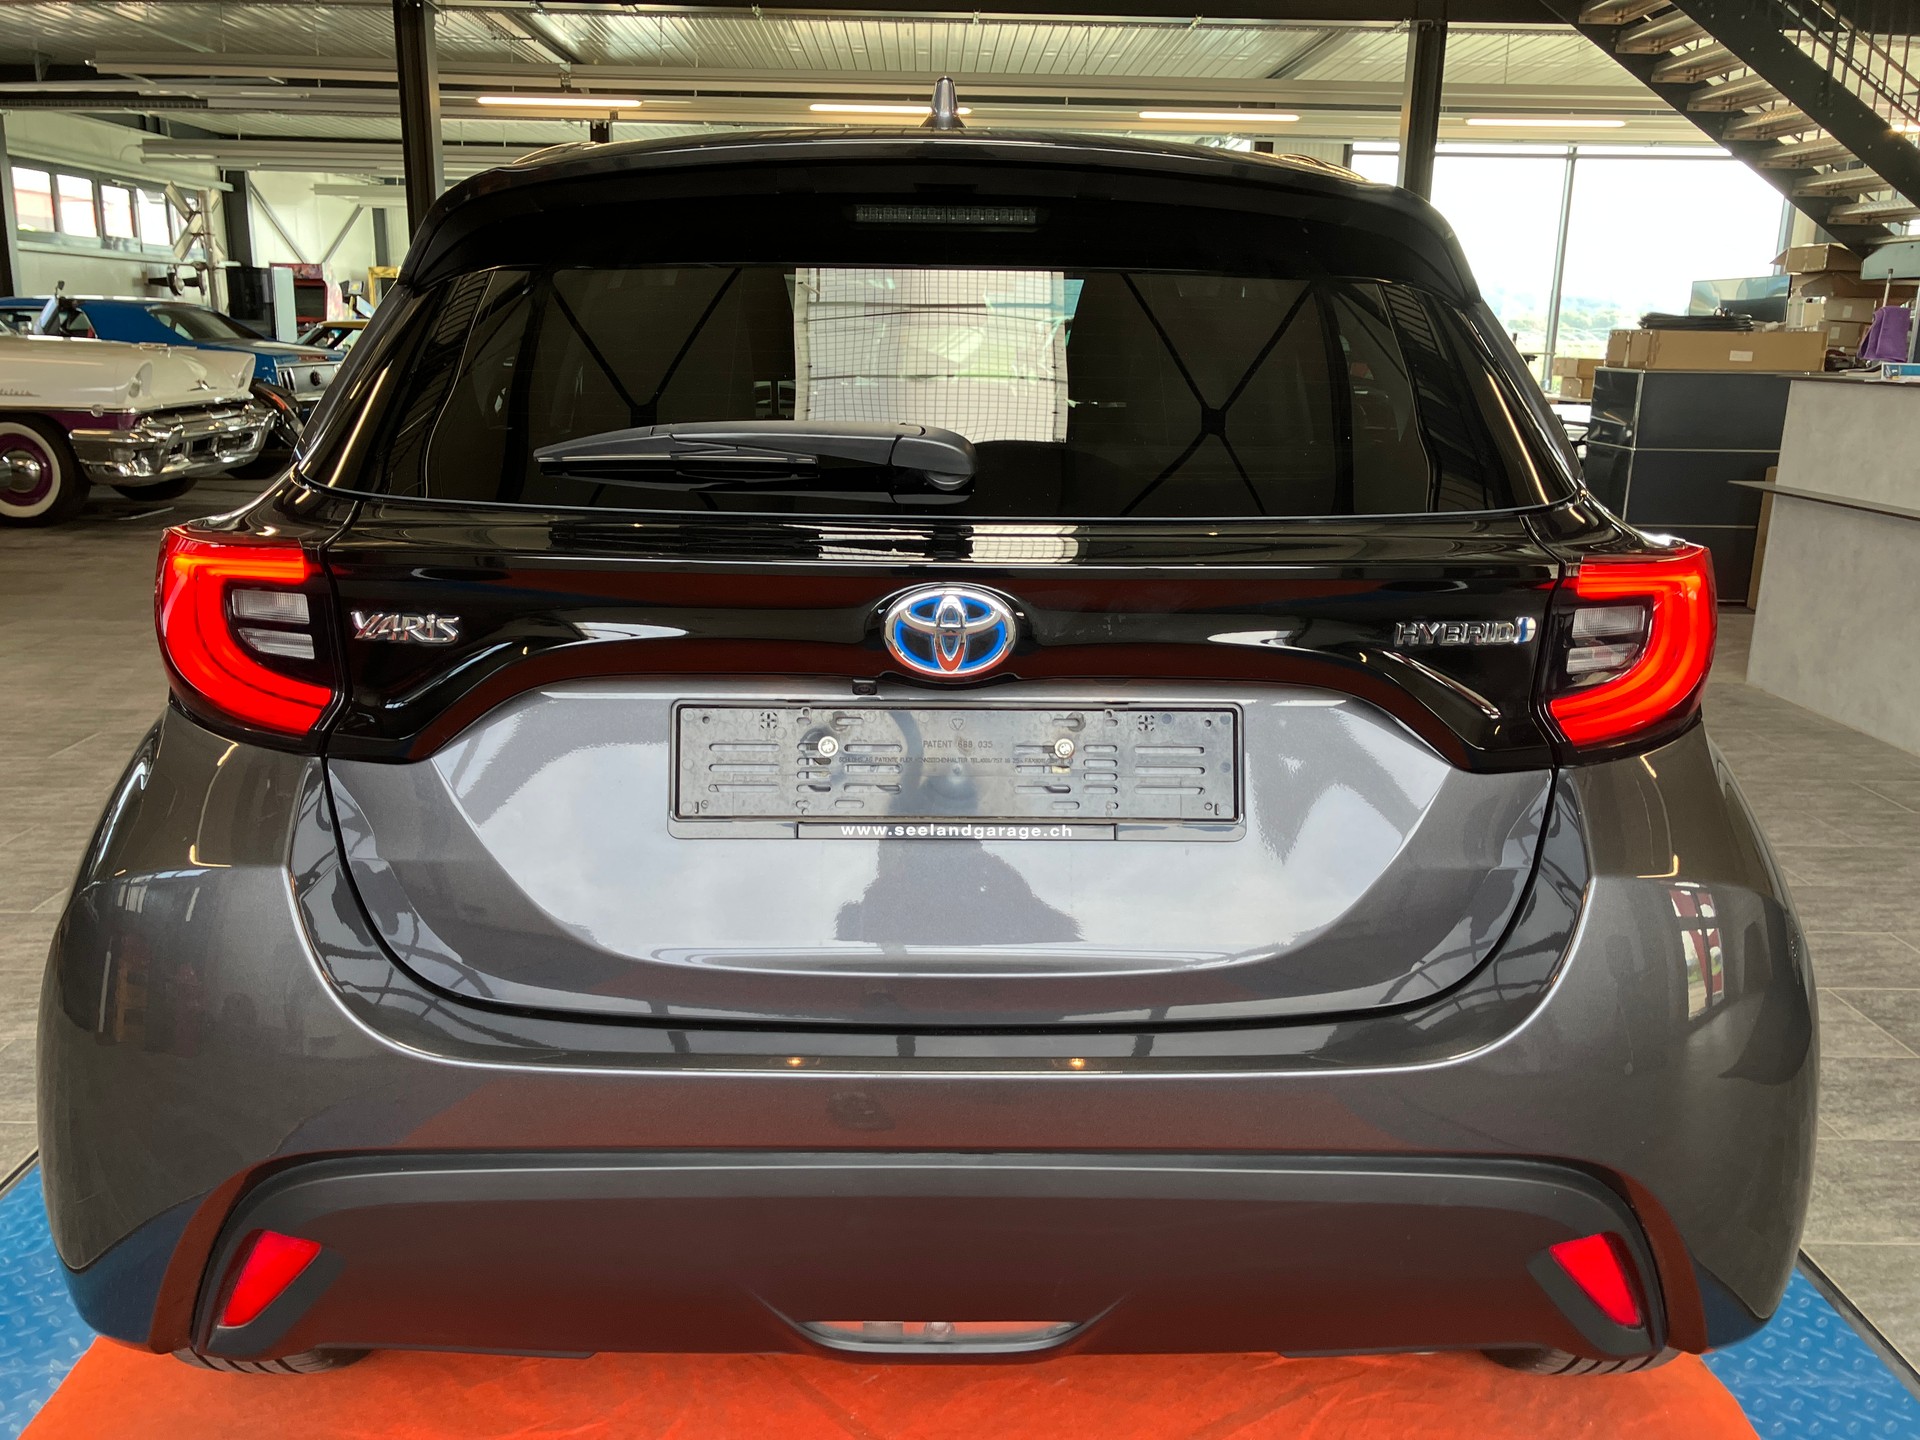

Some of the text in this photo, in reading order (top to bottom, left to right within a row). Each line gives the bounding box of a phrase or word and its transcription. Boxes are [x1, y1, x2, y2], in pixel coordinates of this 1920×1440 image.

[350, 611, 460, 644] YARIS
[1394, 621, 1515, 647] HYBRID
[923, 740, 953, 749] PATENT
[977, 740, 994, 749] 035
[840, 823, 1073, 840] www.seelandgarage.ch
